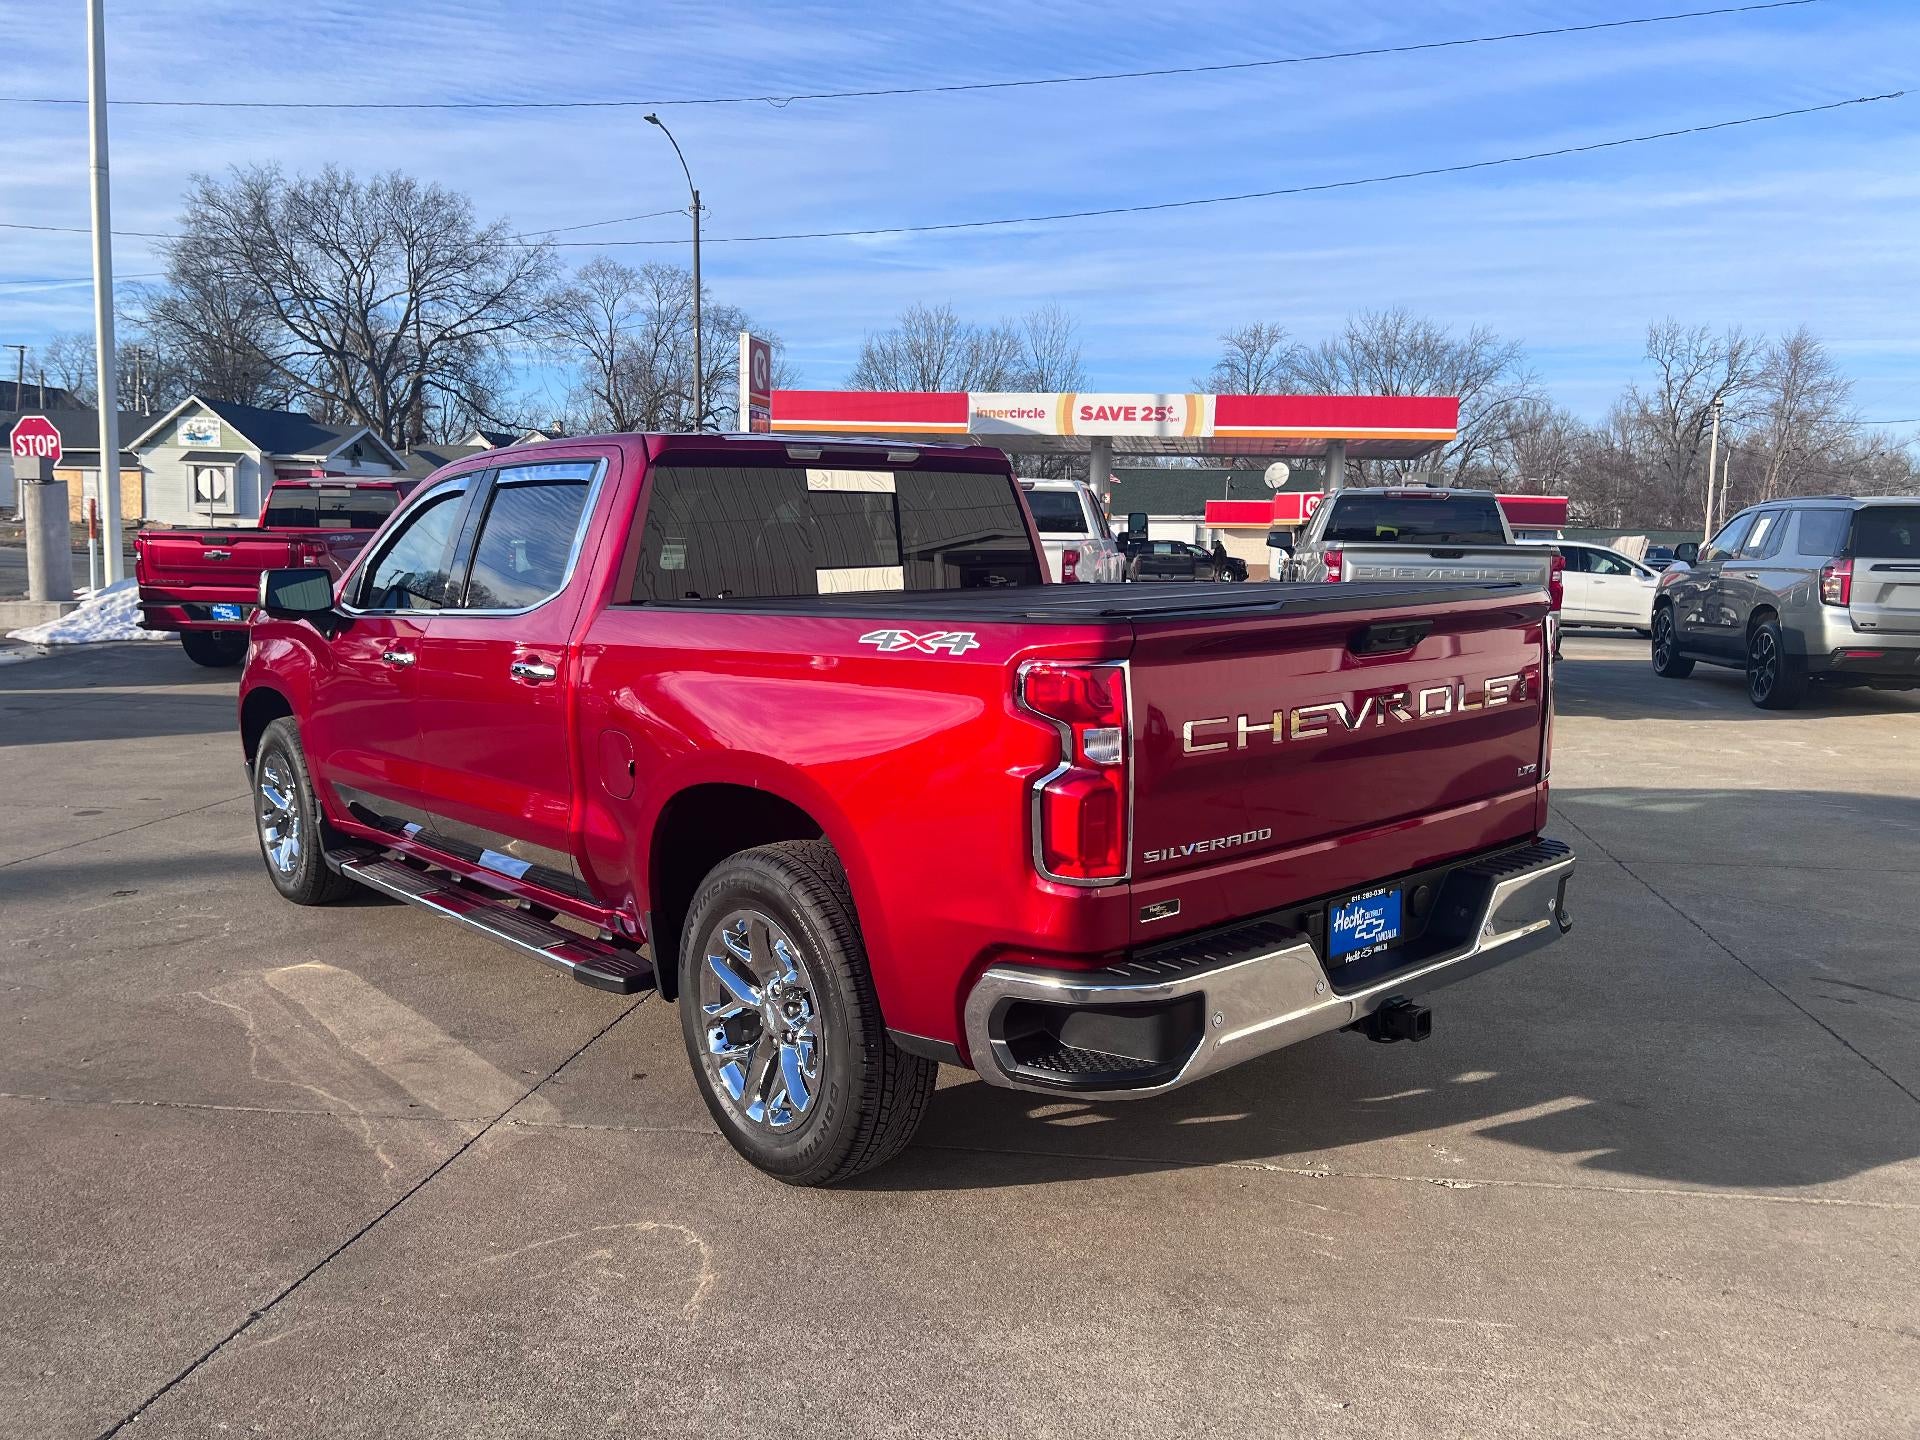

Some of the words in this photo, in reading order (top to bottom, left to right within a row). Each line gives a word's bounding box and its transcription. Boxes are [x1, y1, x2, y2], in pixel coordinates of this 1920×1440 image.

[975, 406, 1046, 420] innercircle
[1079, 405, 1137, 422] SAVE
[16, 434, 58, 457] STOP
[1355, 566, 1538, 581] CHEVROLET
[1182, 673, 1535, 756] CHEVROLET
[1517, 763, 1537, 777] LTZ
[1143, 827, 1272, 864] SILVERADO
[1333, 906, 1365, 933] Hecht
